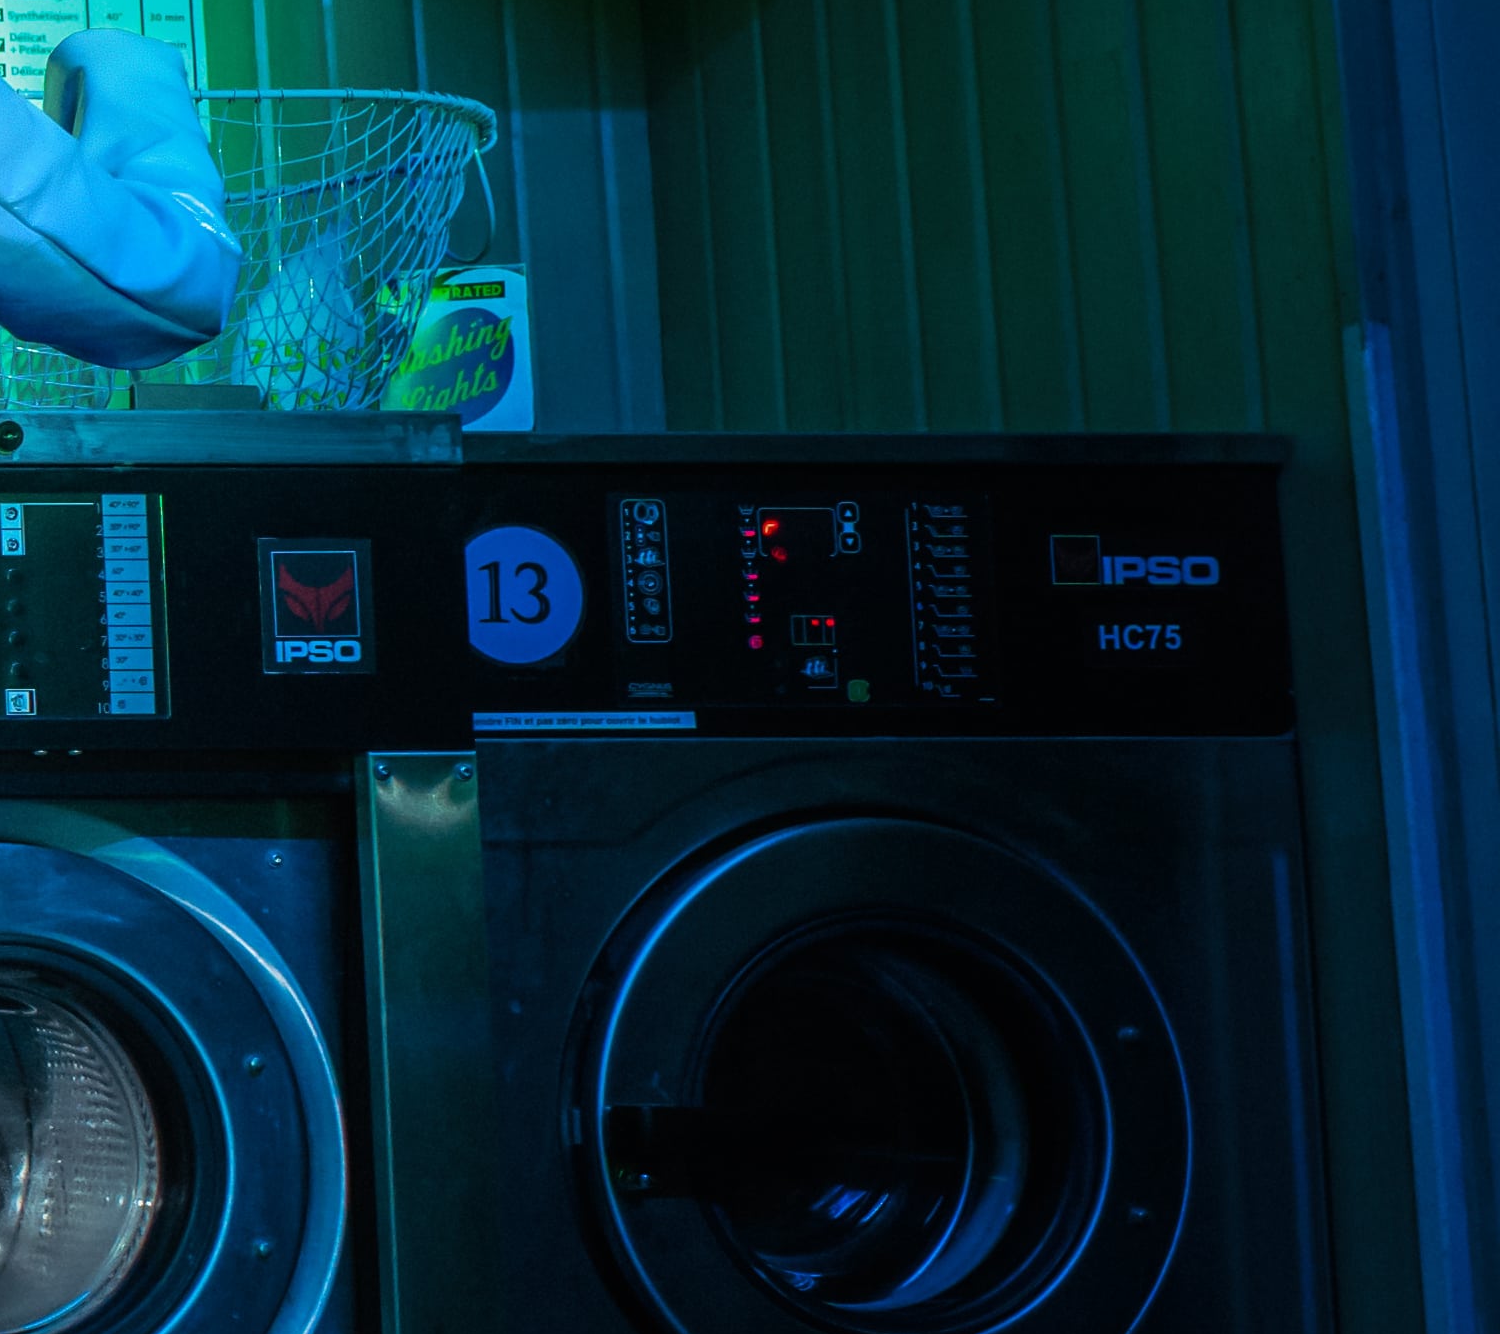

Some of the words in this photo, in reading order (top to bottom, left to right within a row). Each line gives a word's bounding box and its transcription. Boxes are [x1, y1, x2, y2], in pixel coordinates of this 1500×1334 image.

[1101, 555, 1221, 586] IPSO
[477, 560, 551, 625] 13
[274, 638, 363, 665] IPSO
[1096, 623, 1184, 651] HC75
